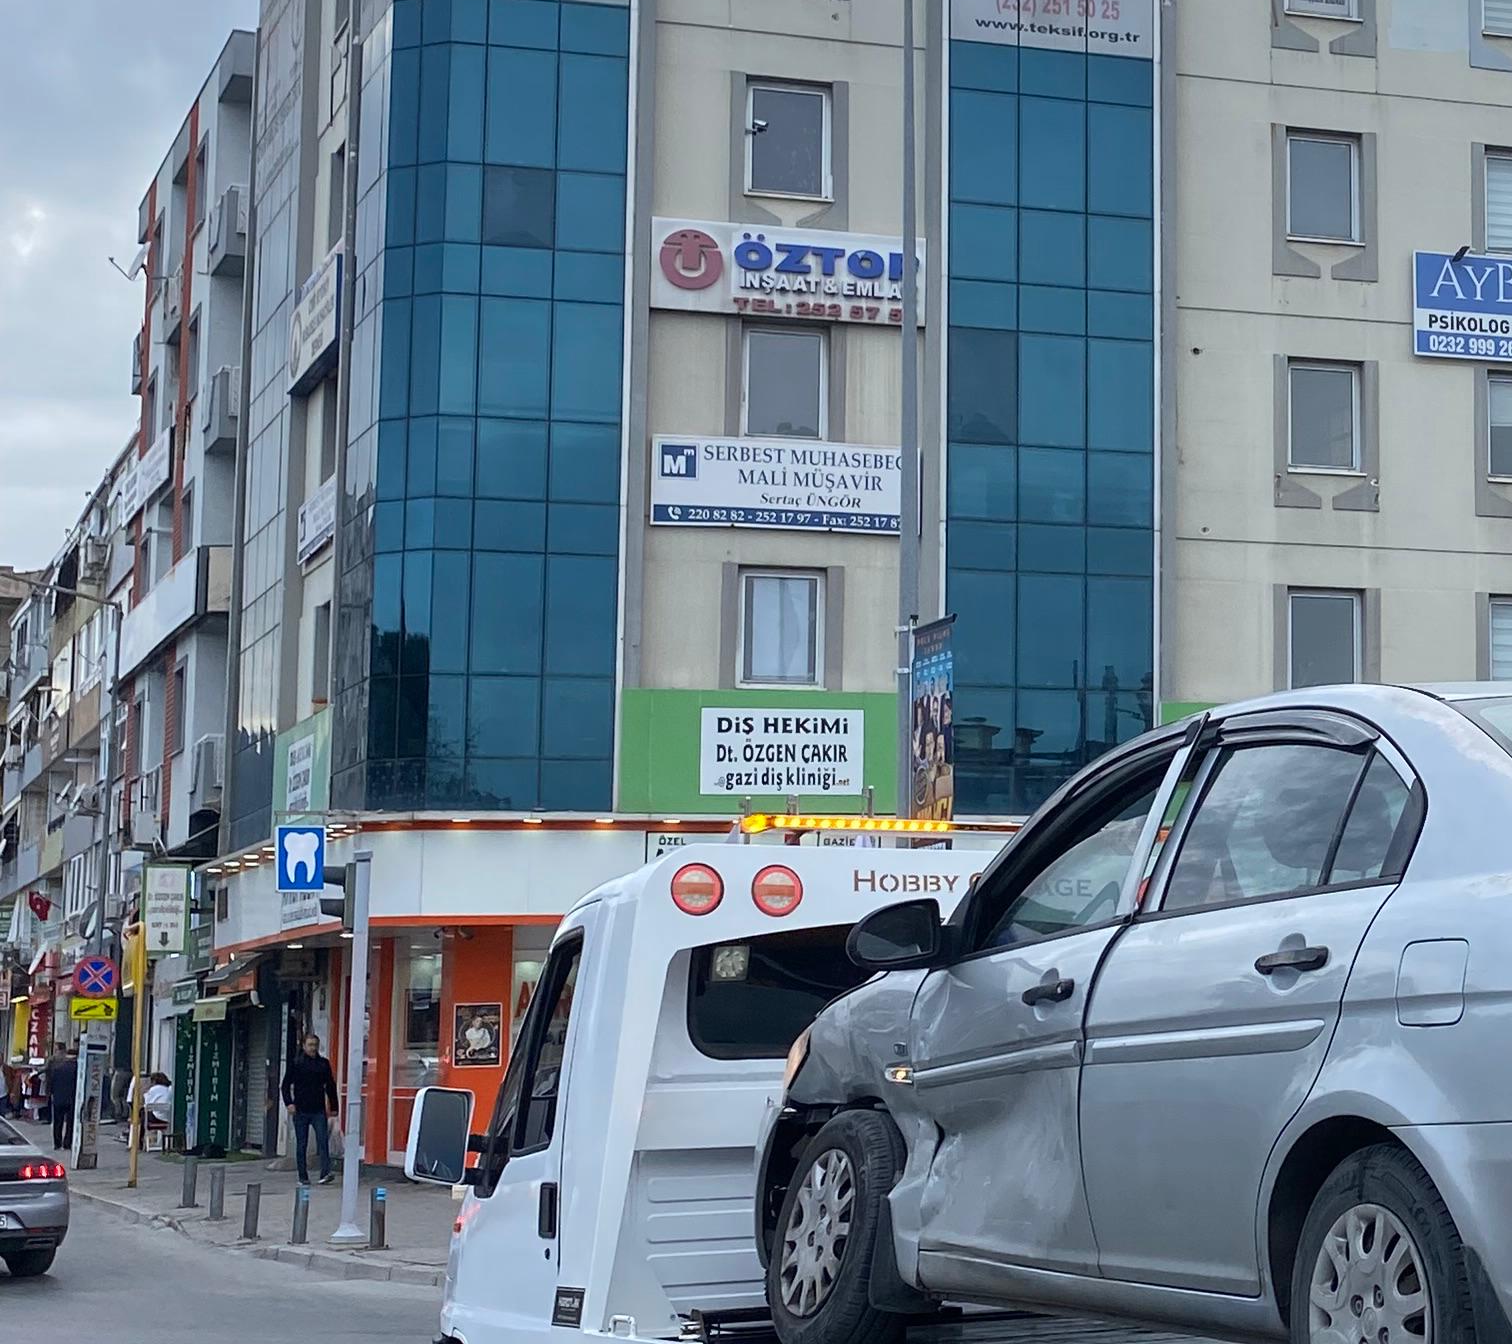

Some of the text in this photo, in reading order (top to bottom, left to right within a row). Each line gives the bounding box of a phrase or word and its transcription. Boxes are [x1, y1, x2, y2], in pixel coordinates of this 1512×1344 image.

[1101, 0, 1121, 21] 25
[975, 18, 1141, 44] www.teksif.org.tr
[825, 279, 839, 294] &
[842, 280, 902, 299] EMLA
[795, 302, 841, 318] 252
[889, 307, 903, 323] 5
[1429, 312, 1509, 334] PSİKOLOG
[1429, 335, 1464, 353] 0232
[1469, 339, 1495, 354] 999
[704, 445, 785, 464] SERBEST
[738, 466, 883, 492] MALİ MÜŞAVİR
[760, 493, 862, 508] Sertaç ÜNGÖR
[688, 507, 710, 521] 220
[713, 509, 727, 521] 82
[731, 509, 745, 522] 82
[756, 511, 776, 523] 252
[780, 512, 793, 523] 17
[797, 512, 811, 524] 97
[850, 515, 871, 528] 252
[874, 515, 887, 528] 17
[716, 738, 848, 764] Dt. ÖZGEN ÇAKIR
[658, 835, 687, 846] ÖZEL
[823, 837, 856, 847] GAZİE
[853, 869, 960, 893] HOBBY
